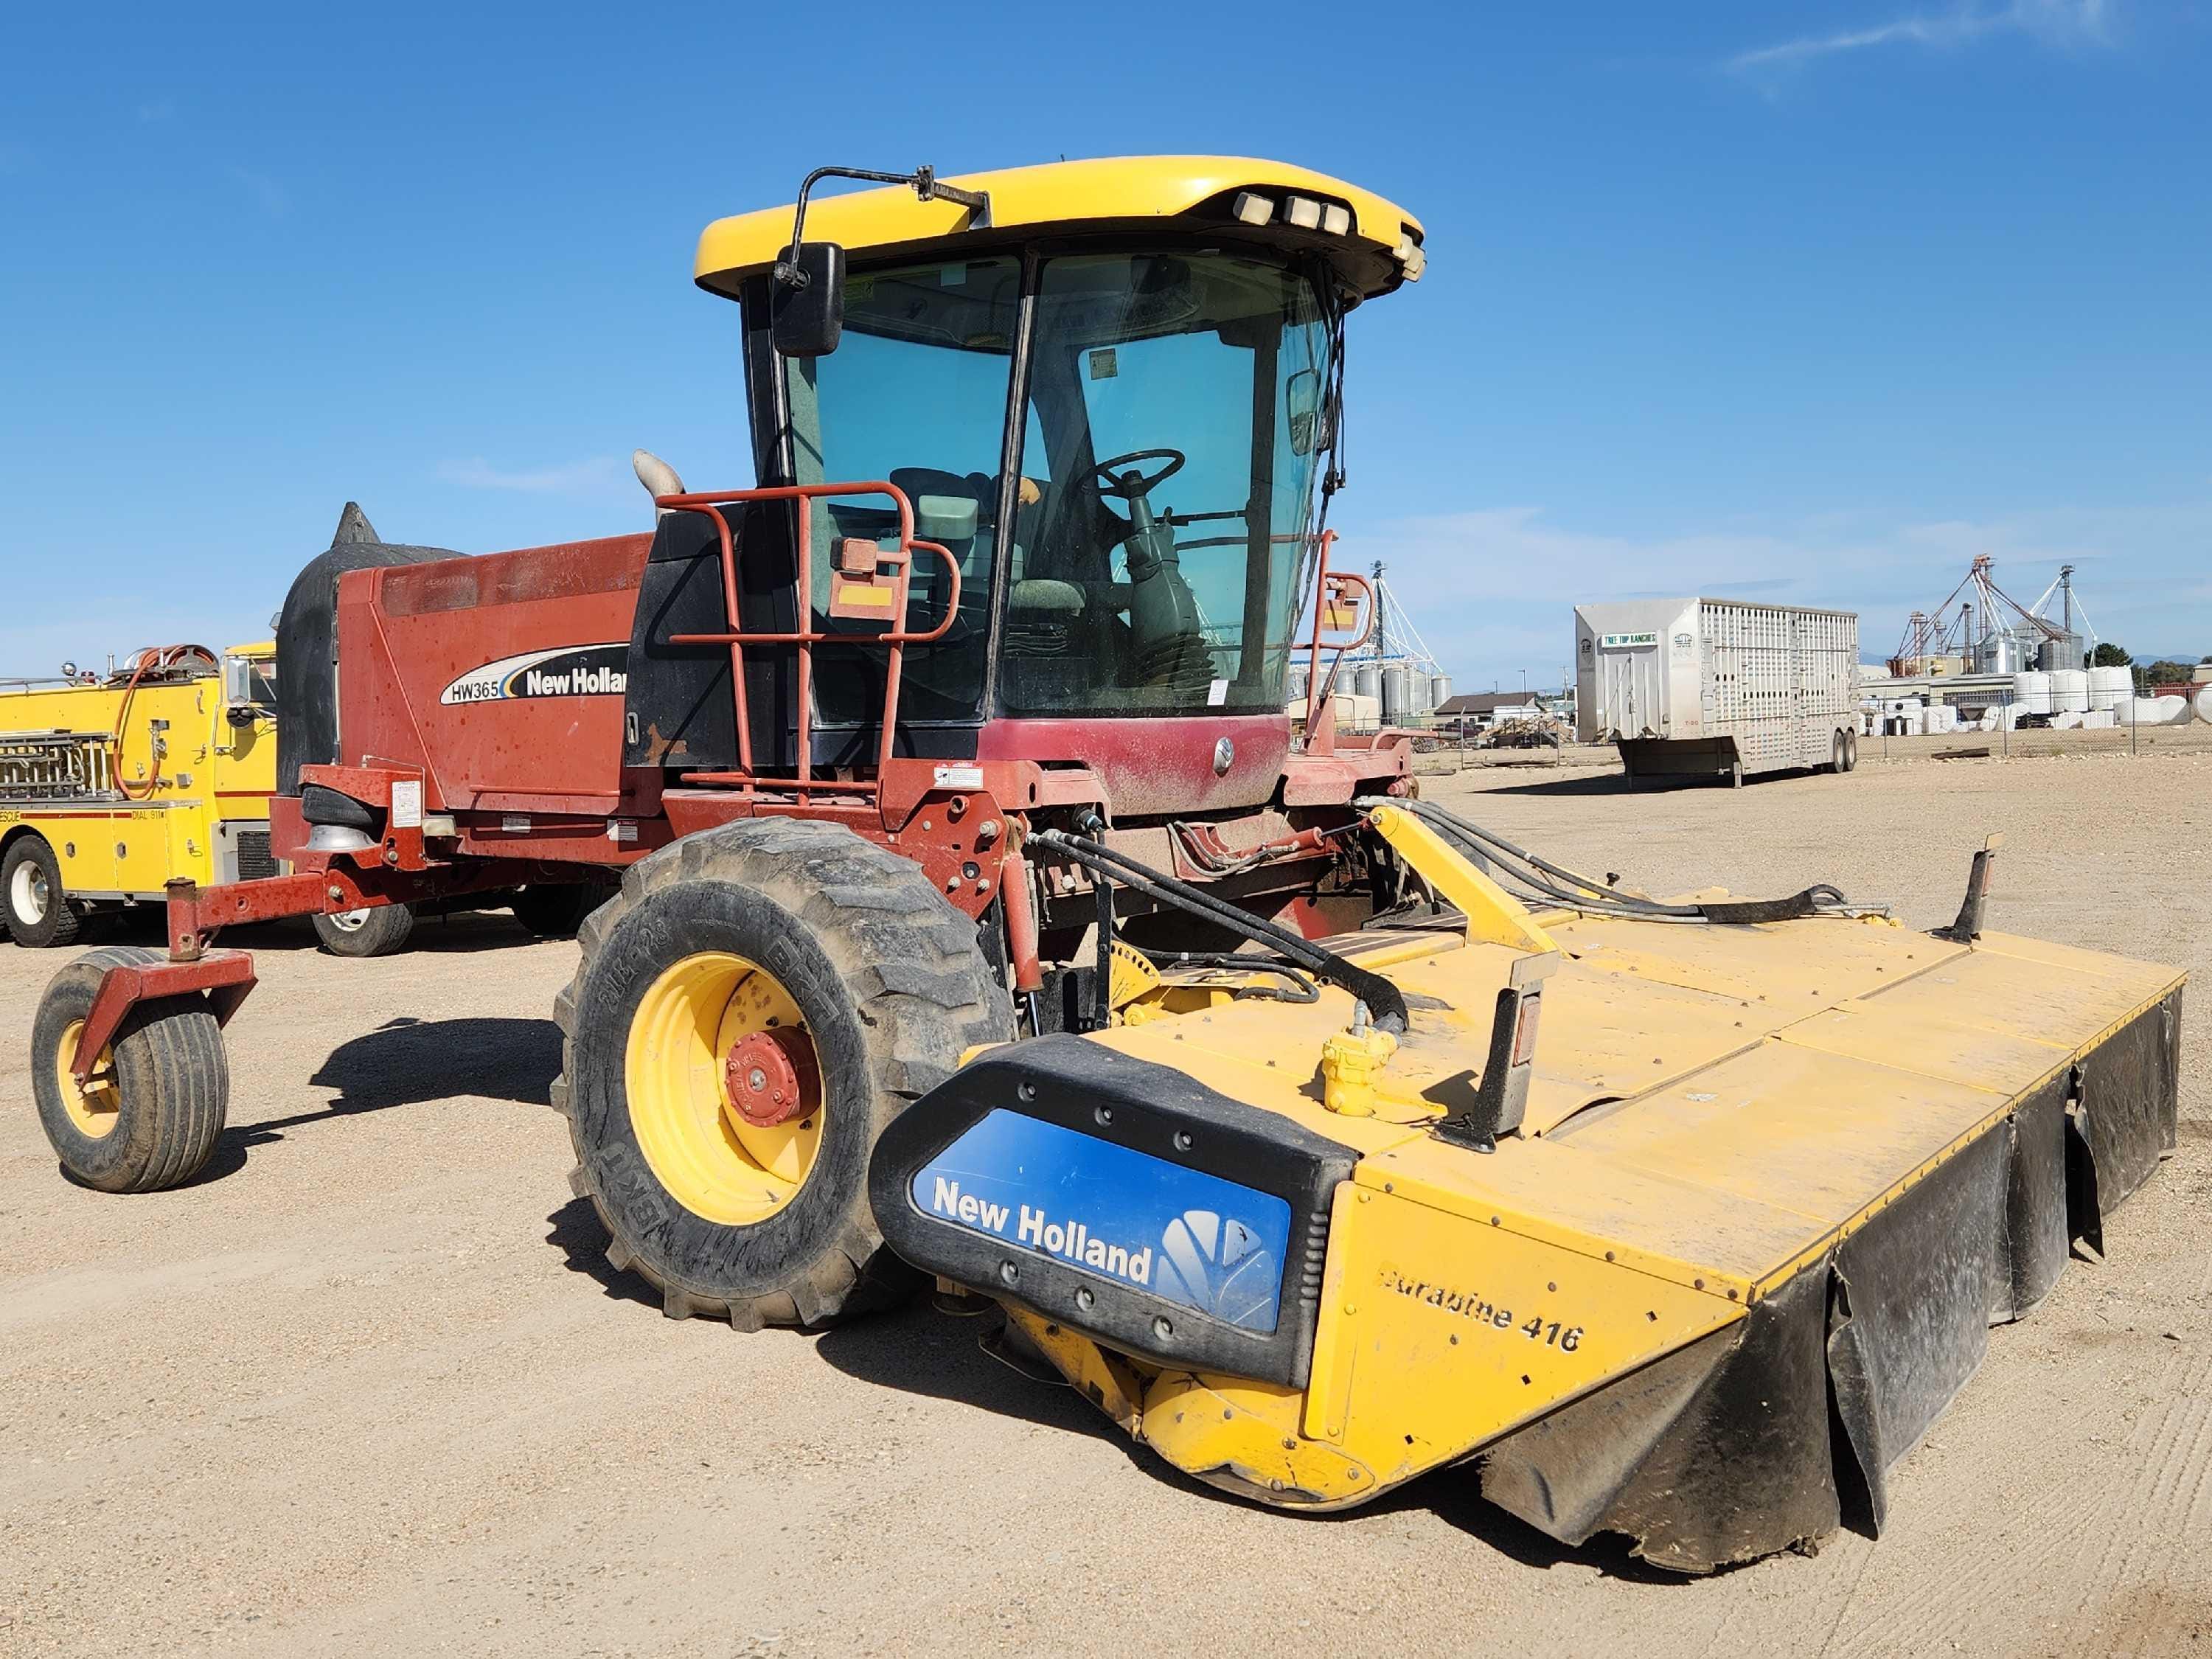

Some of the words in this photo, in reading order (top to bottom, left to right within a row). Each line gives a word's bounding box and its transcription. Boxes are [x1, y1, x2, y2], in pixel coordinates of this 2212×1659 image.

[1604, 635, 1617, 644] TREE
[1619, 635, 1630, 644] TOP
[452, 681, 498, 701] HW365
[526, 669, 571, 696] New
[933, 1176, 1009, 1232] New
[1018, 1203, 1152, 1285] Holland
[1379, 1268, 1512, 1328] urabine
[1522, 1317, 1584, 1352] 416
